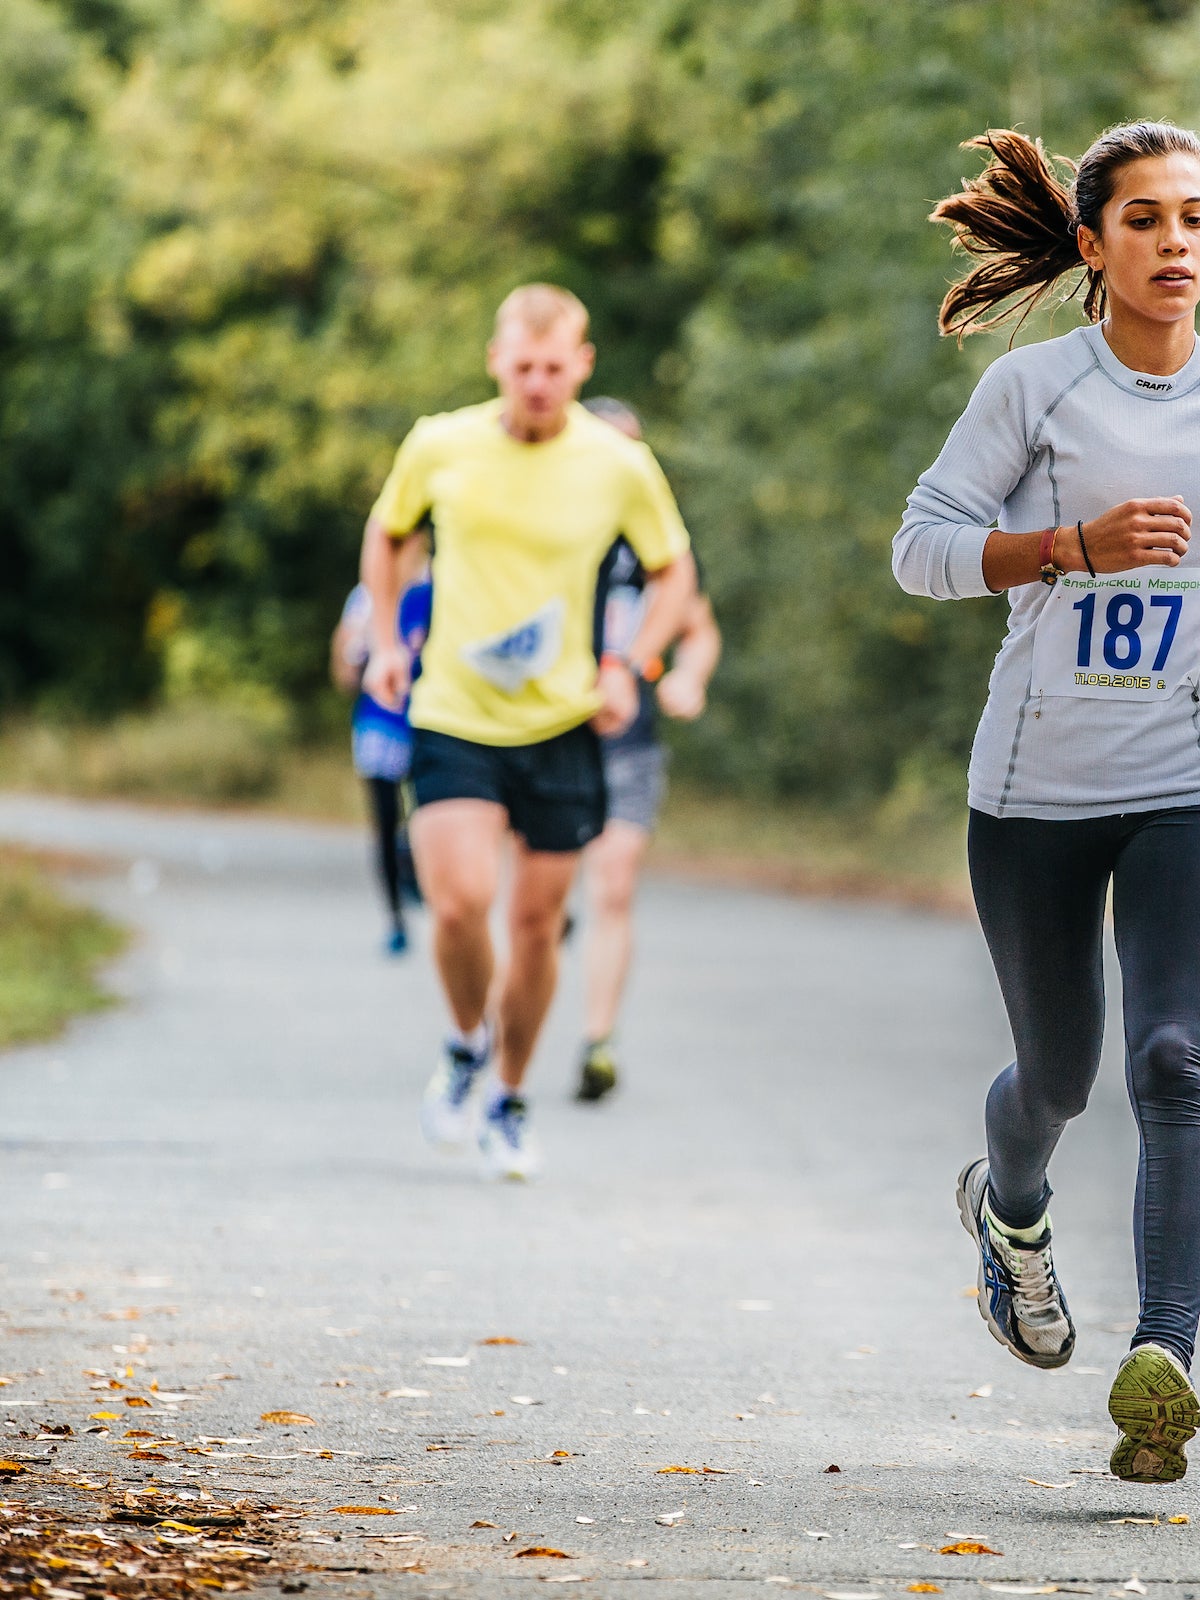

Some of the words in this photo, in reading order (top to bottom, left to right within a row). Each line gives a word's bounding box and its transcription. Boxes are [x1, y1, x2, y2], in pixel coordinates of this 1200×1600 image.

[1135, 379, 1167, 391] CRAFT
[1072, 592, 1183, 671] 187
[1074, 672, 1151, 689] 11.09.2016
